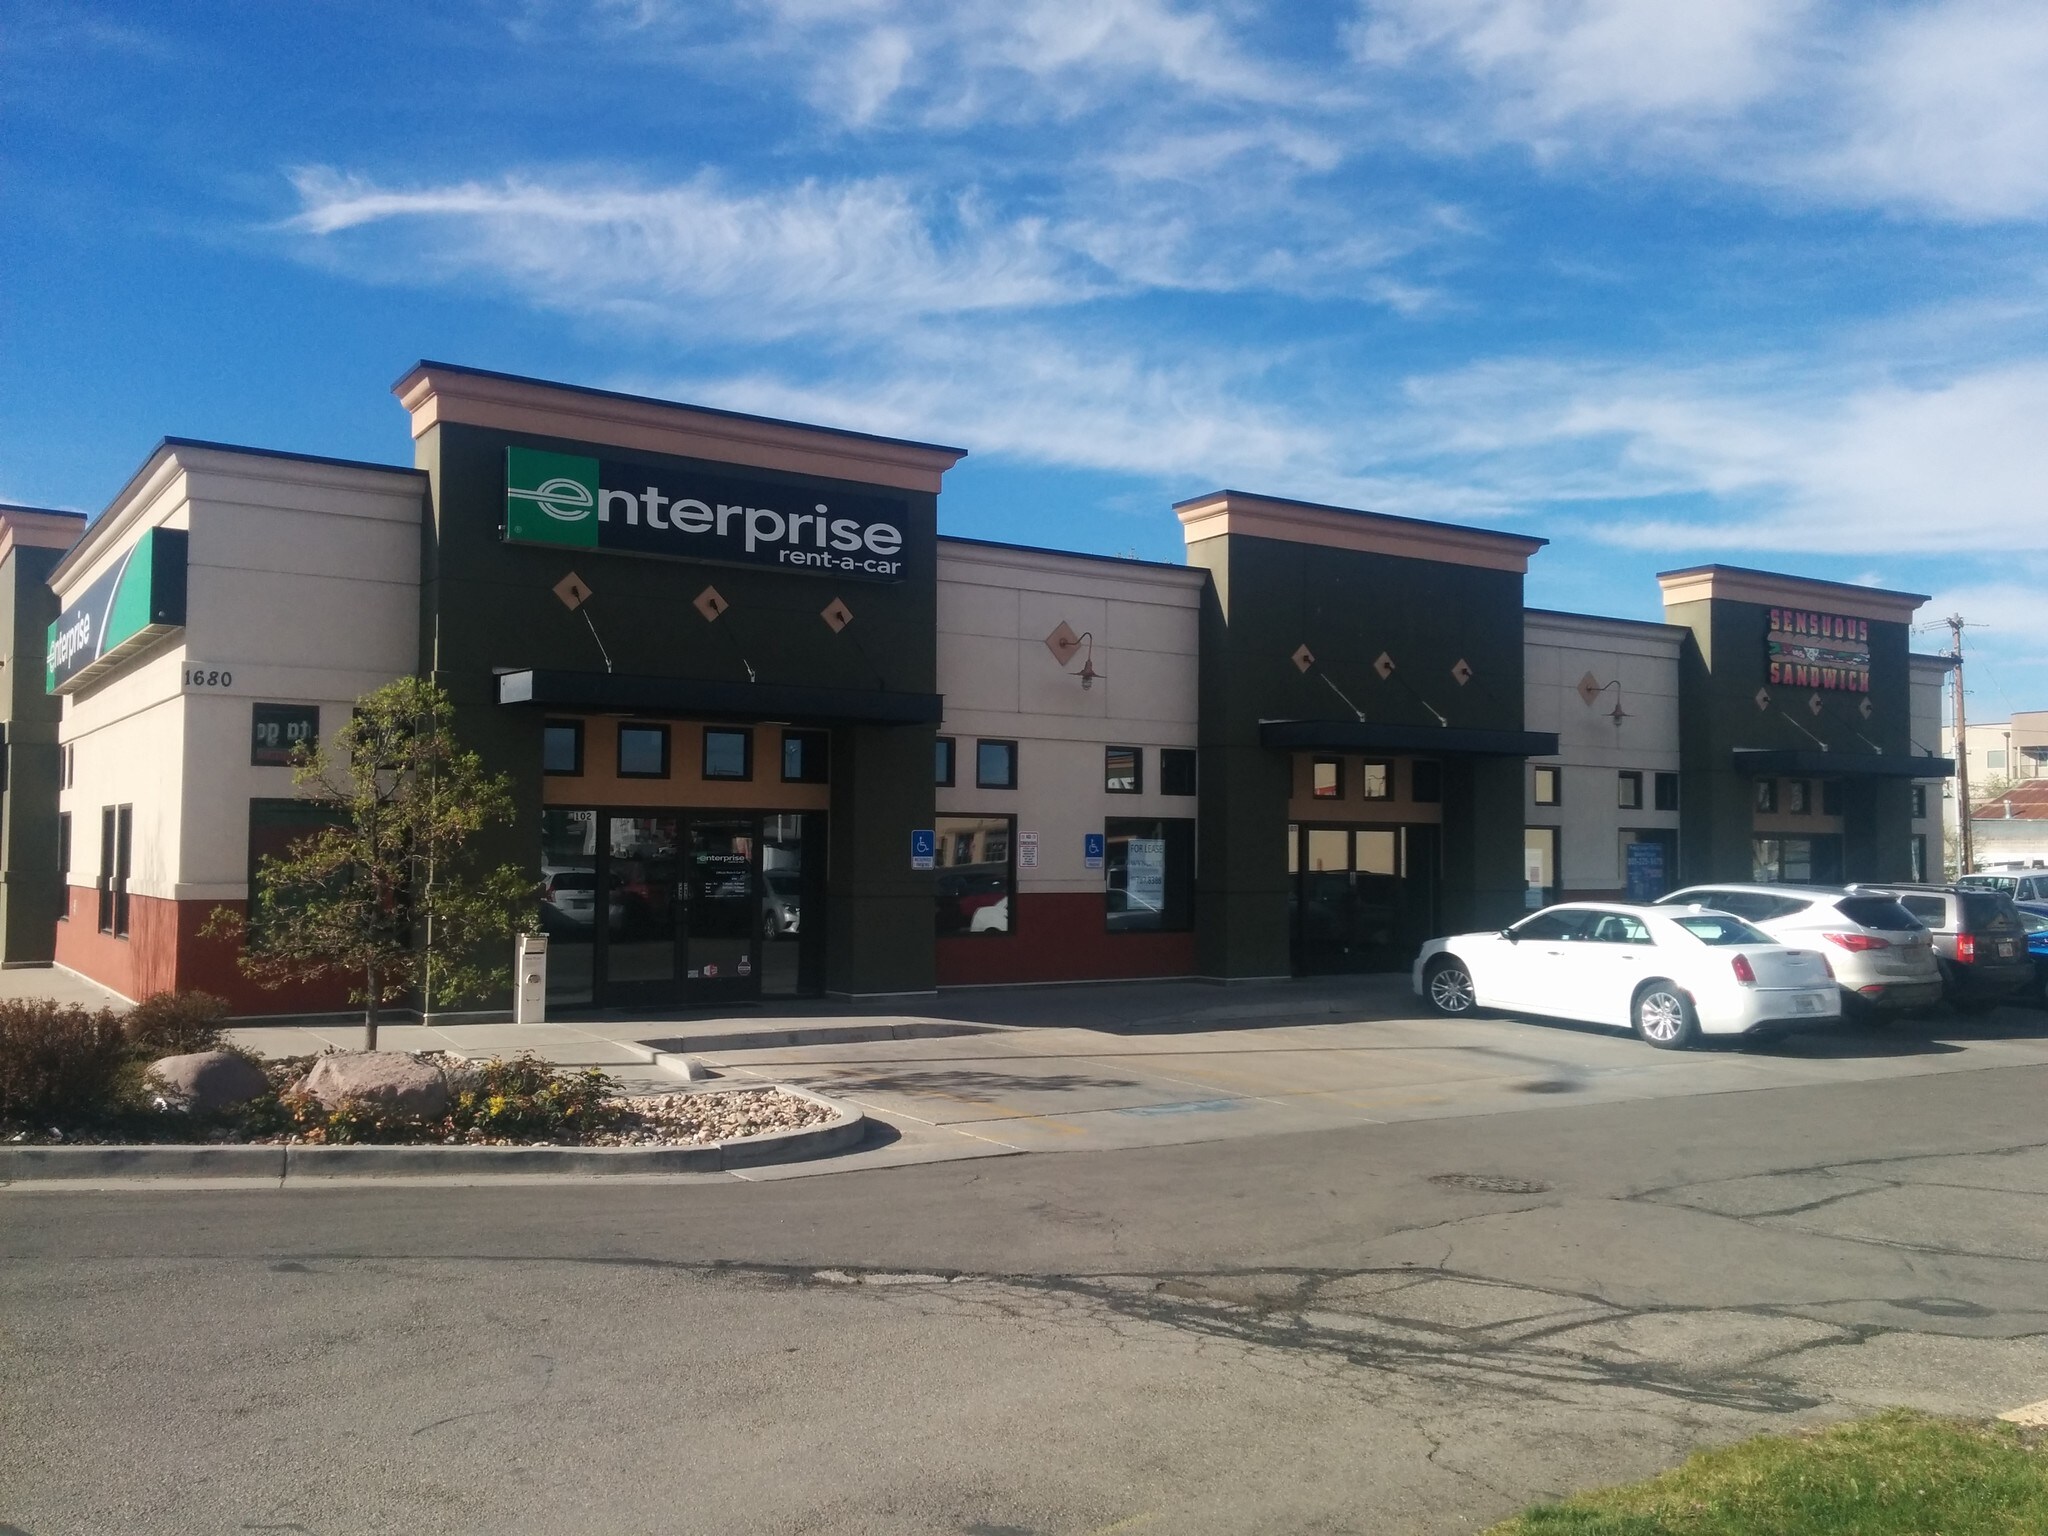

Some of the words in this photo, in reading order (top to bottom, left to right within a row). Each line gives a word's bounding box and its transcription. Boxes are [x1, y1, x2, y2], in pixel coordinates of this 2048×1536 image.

[508, 477, 903, 555] enterprise
[779, 548, 902, 575] rent-a-car
[1770, 608, 1868, 641] SENSUOUS
[46, 610, 91, 674] enterprise
[185, 669, 232, 687] 1680
[1770, 662, 1869, 692] SANDWICH
[575, 812, 592, 821] 102
[697, 854, 745, 863] enterprise
[1130, 844, 1143, 853] FOR
[1144, 844, 1163, 854] LEASE
